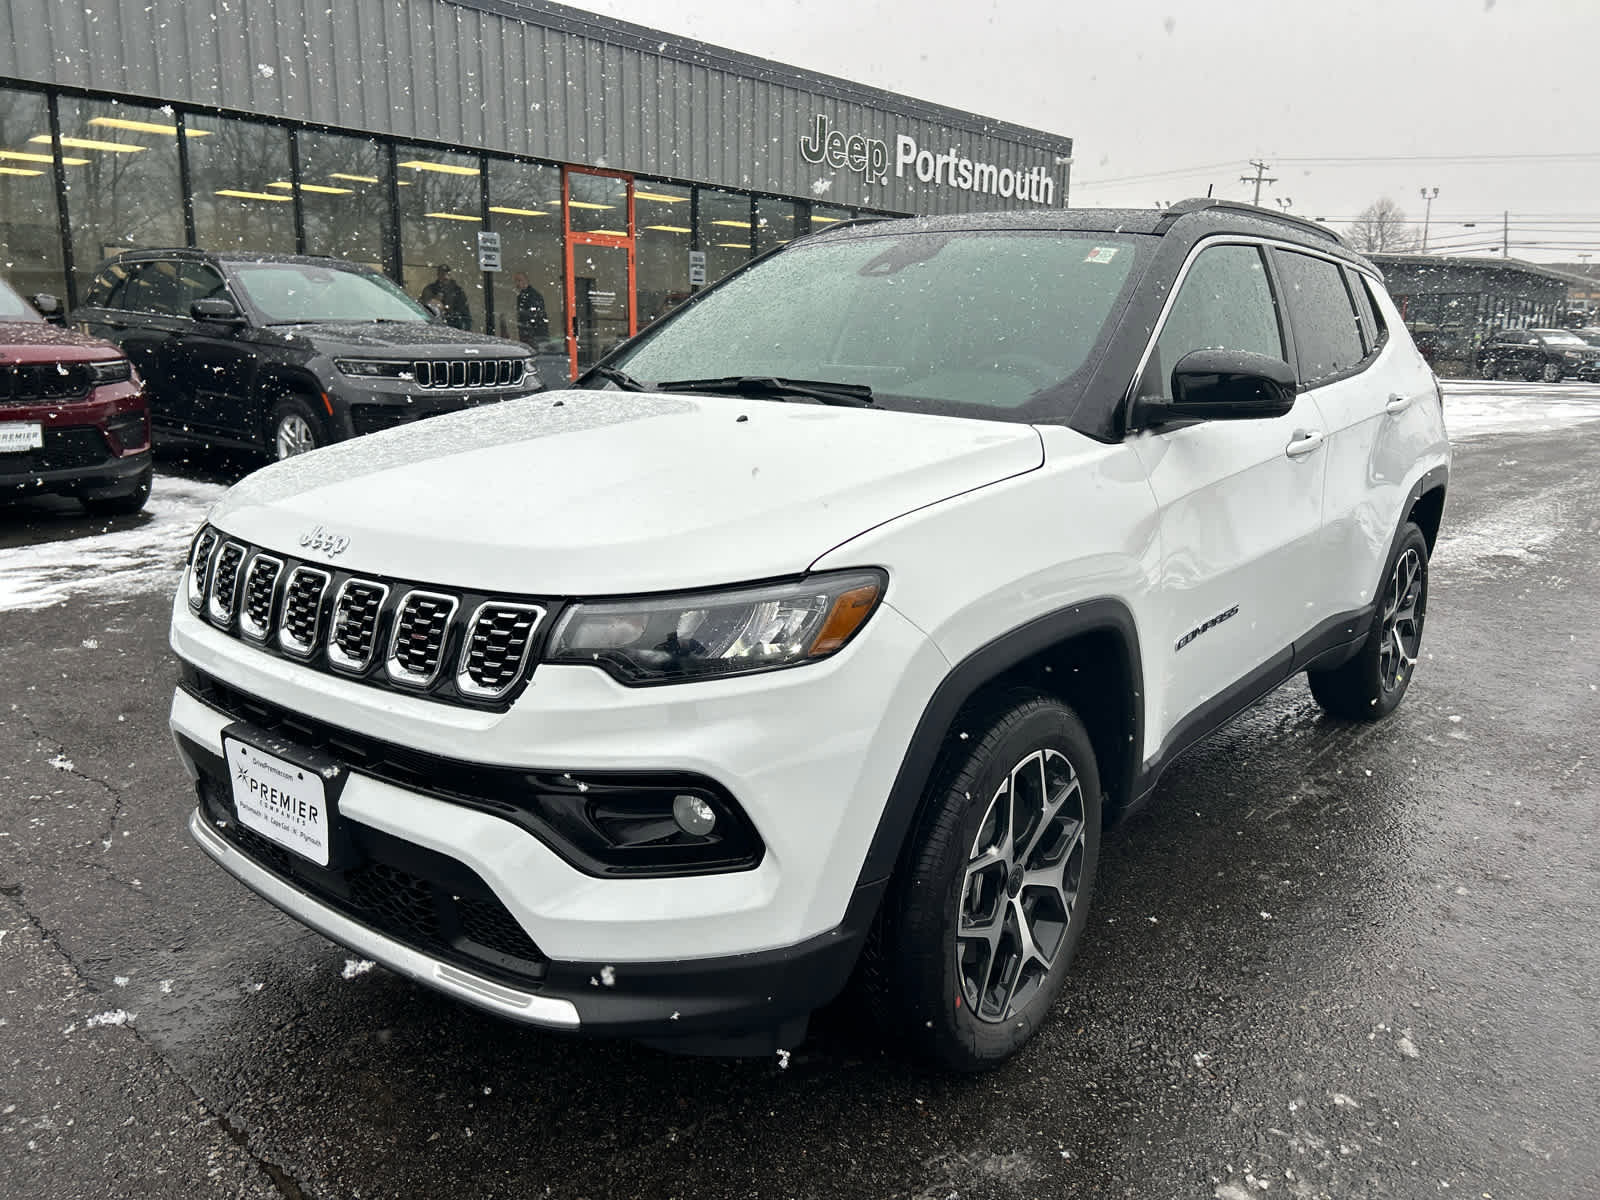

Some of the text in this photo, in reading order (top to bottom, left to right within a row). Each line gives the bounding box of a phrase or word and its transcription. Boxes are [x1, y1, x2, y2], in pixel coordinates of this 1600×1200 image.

[801, 114, 1054, 204] Jeep Portsmouth
[0, 432, 38, 440] REMIER
[299, 526, 351, 559] Jeep
[1175, 604, 1239, 652] COMPASS
[250, 778, 318, 825] PREMIER
